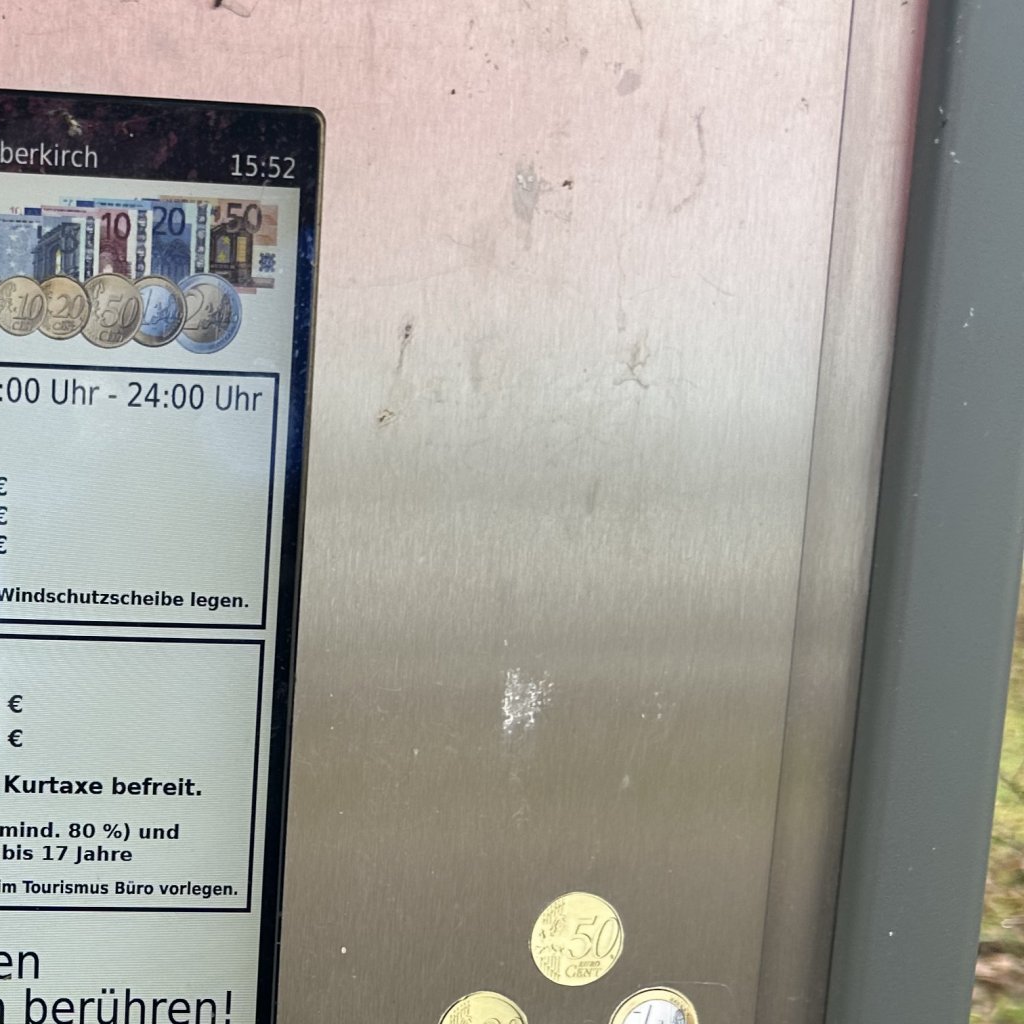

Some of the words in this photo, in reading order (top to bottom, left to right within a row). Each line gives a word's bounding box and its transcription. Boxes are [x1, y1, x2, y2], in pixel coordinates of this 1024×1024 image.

[230, 153, 297, 180] 15:52
[101, 212, 132, 241] 10
[152, 206, 186, 236] 20
[227, 203, 263, 234] 50
[13, 293, 44, 320] 10
[52, 294, 84, 319] 20
[100, 296, 139, 329] 50
[51, 378, 100, 406] Uhr
[127, 381, 205, 411] 24:00
[215, 384, 263, 412] Uhr
[190, 591, 249, 612] legen.
[7, 694, 23, 714] €
[7, 728, 23, 748] €
[4, 774, 103, 795] Kurtaxe
[111, 776, 202, 797] befreit.
[68, 822, 96, 839] 80
[102, 822, 131, 842] %)
[139, 823, 180, 840] und
[2, 843, 34, 861] bis
[42, 845, 68, 861] 17
[73, 845, 133, 865] Jahre
[21, 879, 109, 895] Tourismus
[114, 880, 154, 896] Büro
[159, 880, 238, 899] vorlegen.
[568, 915, 619, 960] 50
[579, 960, 600, 968] EURO
